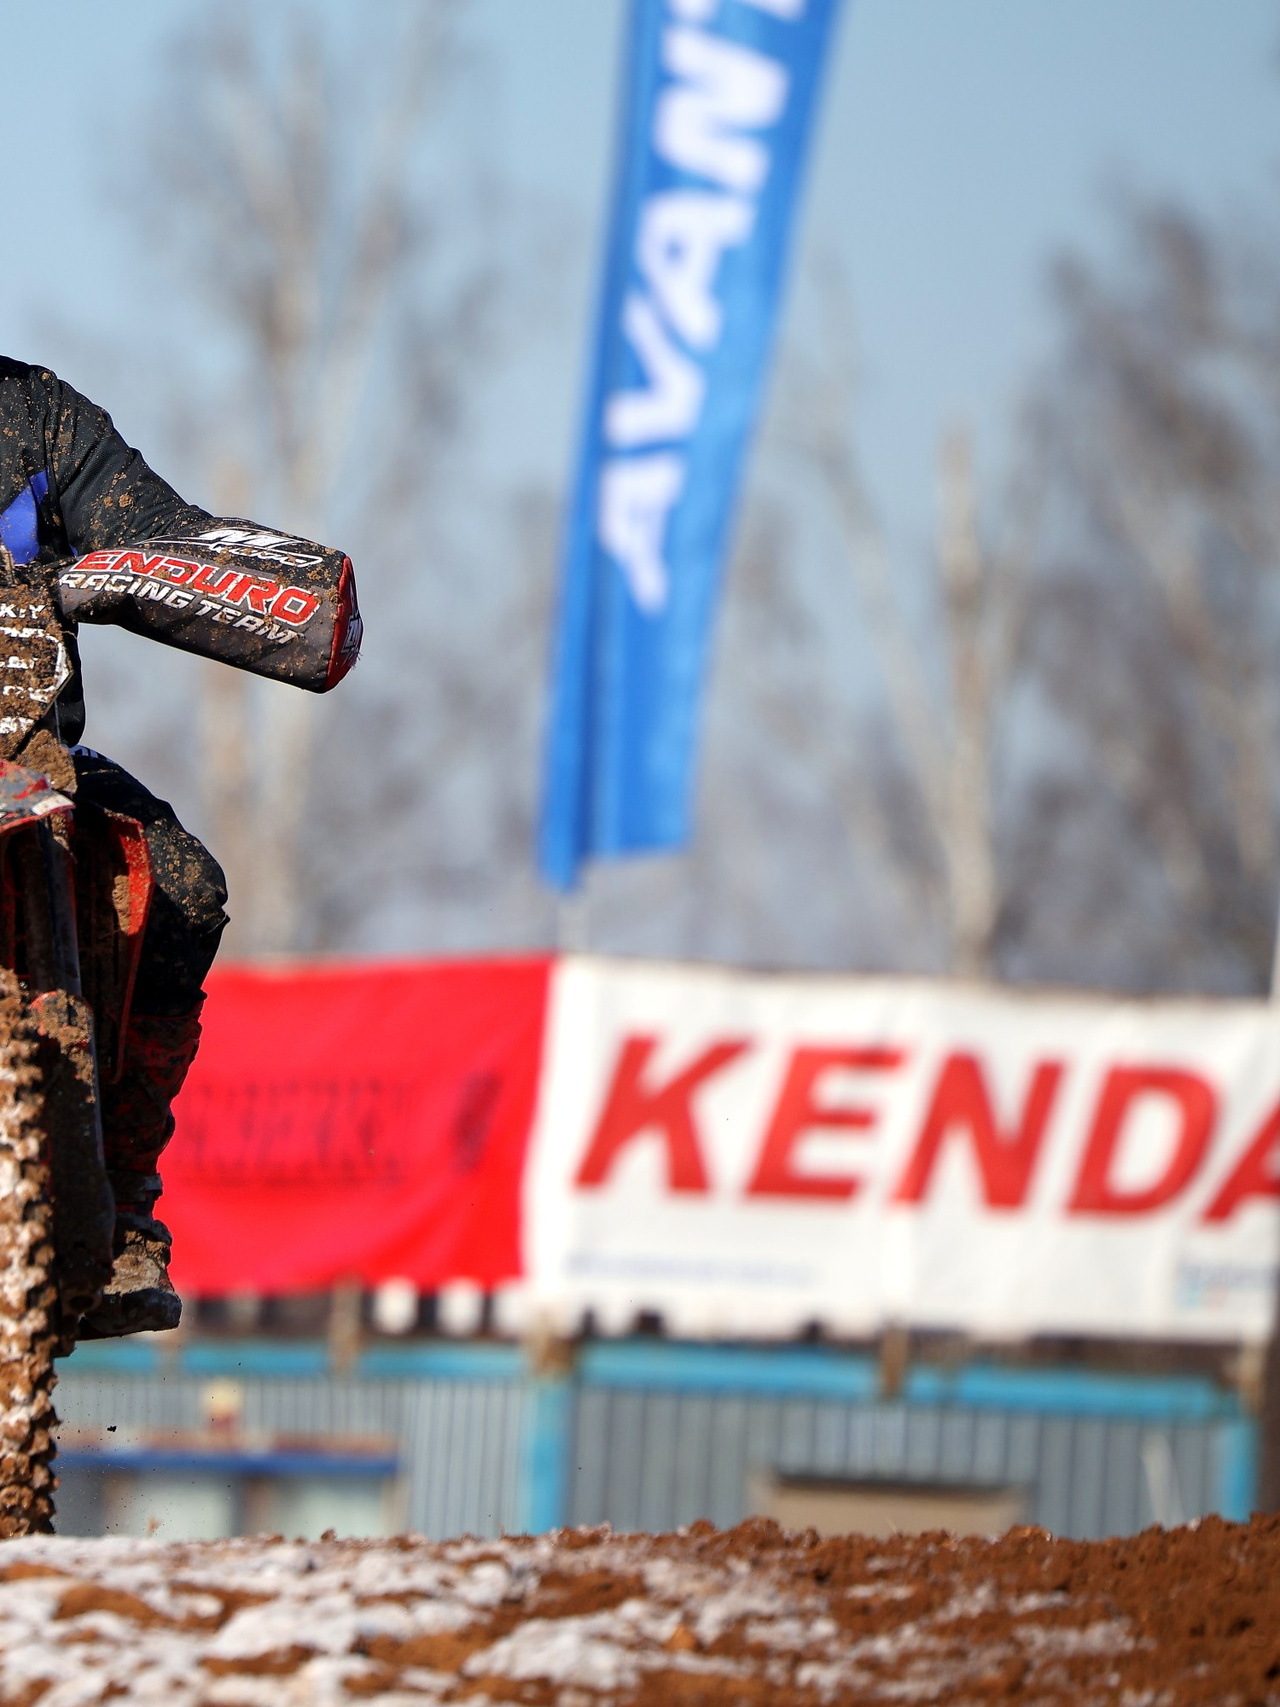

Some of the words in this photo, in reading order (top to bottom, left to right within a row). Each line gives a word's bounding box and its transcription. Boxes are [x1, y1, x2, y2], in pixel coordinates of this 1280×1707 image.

[60, 573, 195, 609] RACING
[195, 600, 307, 645] TEAM
[68, 550, 322, 627] ENDURO
